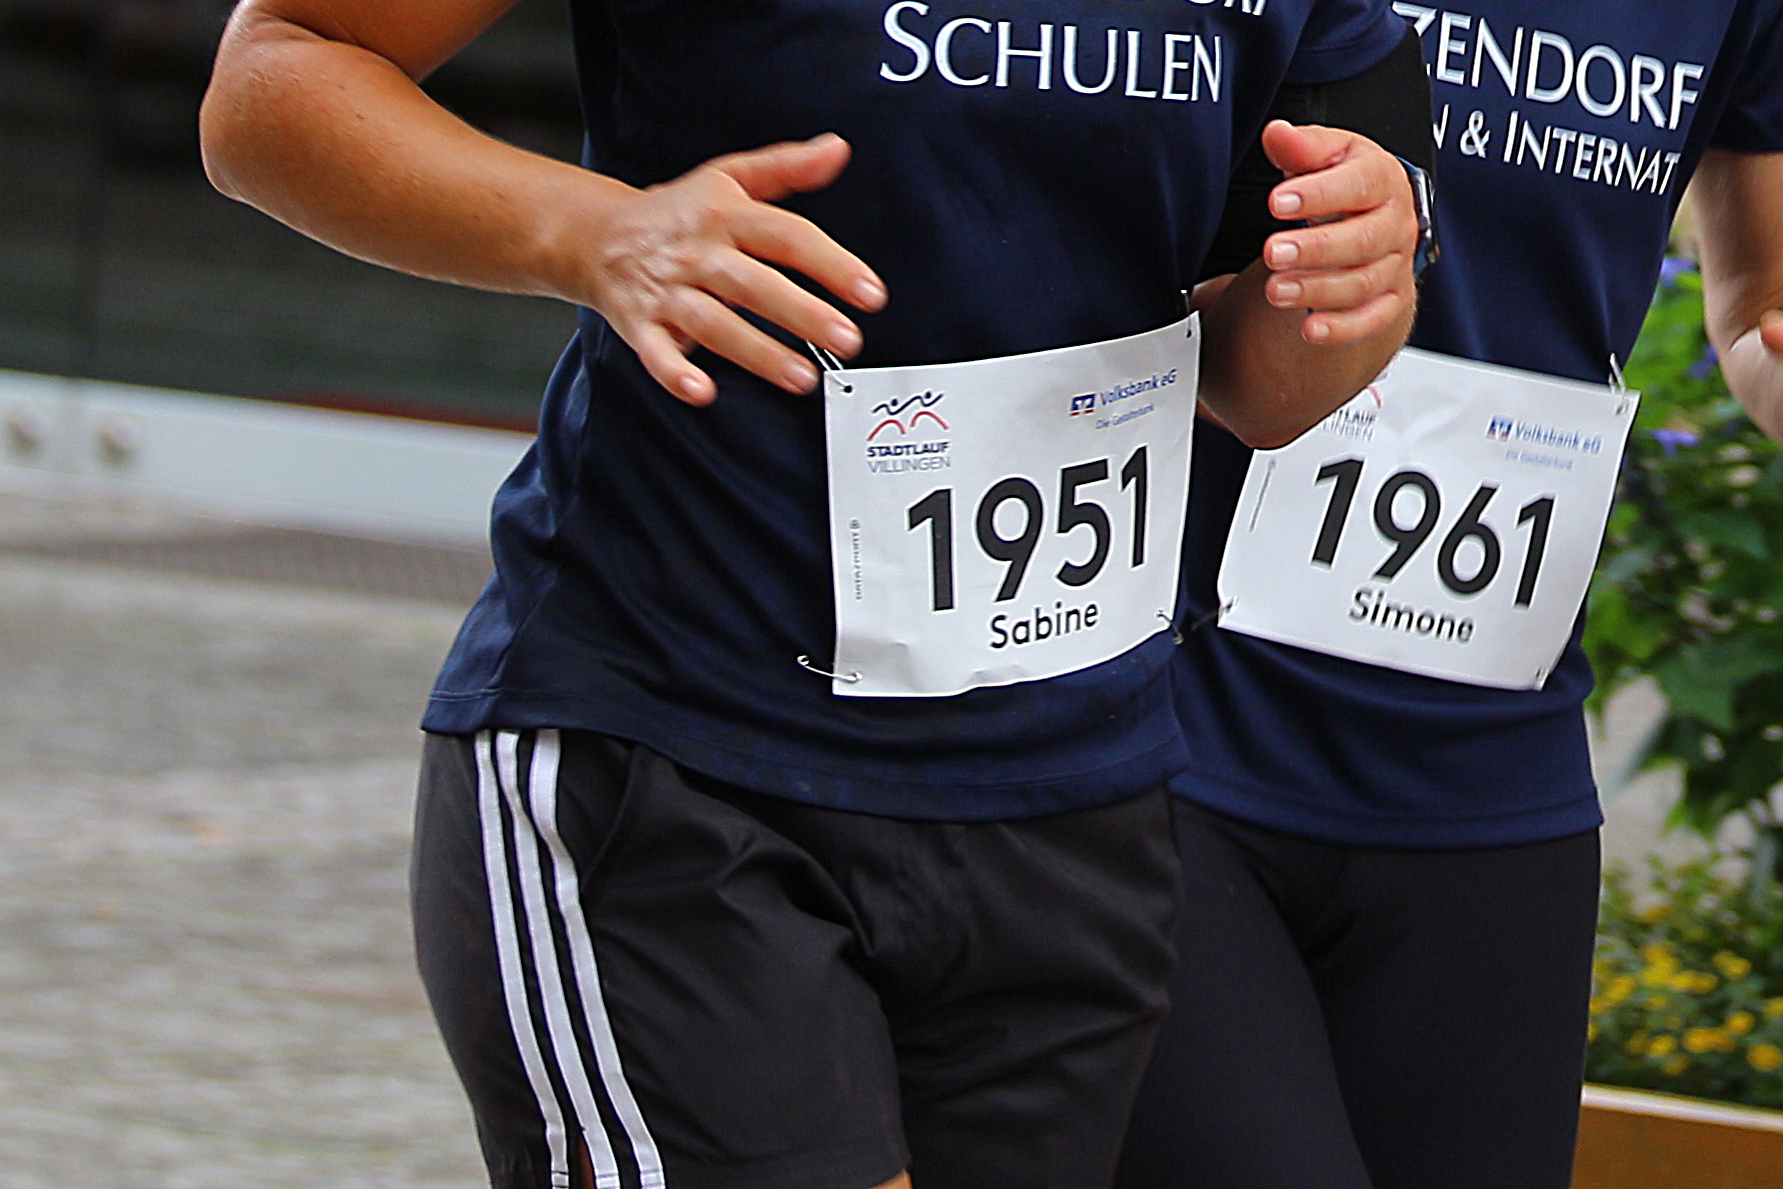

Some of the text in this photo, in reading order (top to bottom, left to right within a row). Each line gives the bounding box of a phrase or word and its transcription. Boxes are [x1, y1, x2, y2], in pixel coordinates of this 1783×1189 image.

[879, 1, 1223, 103] SCHULEN
[1460, 110, 1490, 158] &
[1503, 110, 1681, 195] INTERNAT
[867, 441, 949, 457] STADTLAUF
[867, 456, 951, 473] VILLINGEN
[907, 446, 1148, 612] 1951
[1311, 458, 1555, 609] 1961
[990, 601, 1098, 649] Sabine
[1348, 587, 1475, 643] Simone
